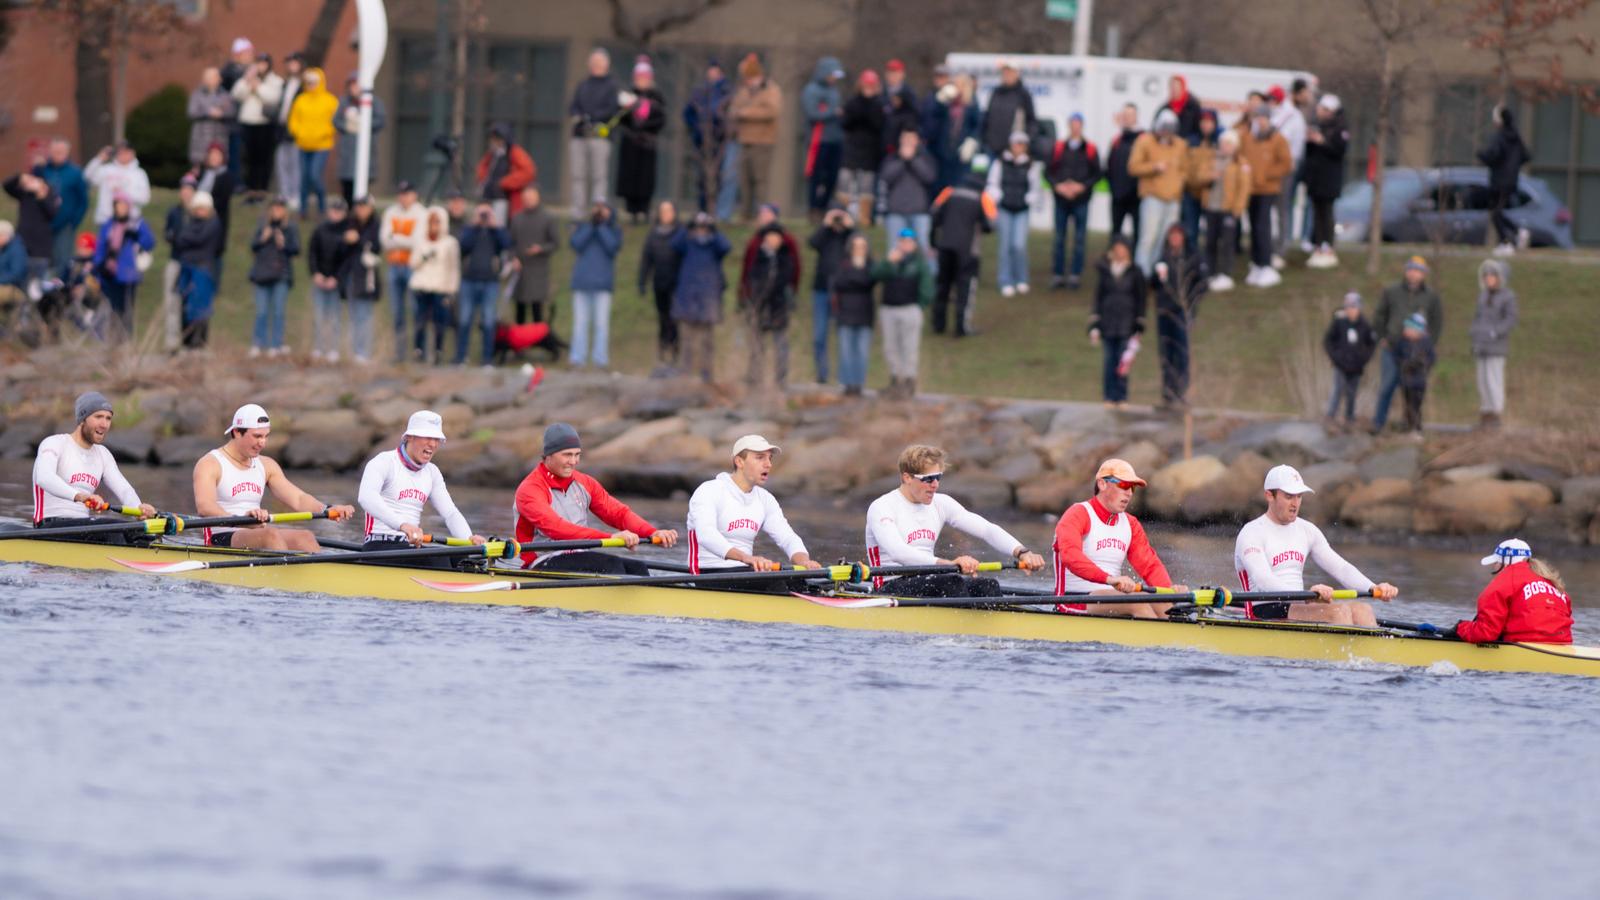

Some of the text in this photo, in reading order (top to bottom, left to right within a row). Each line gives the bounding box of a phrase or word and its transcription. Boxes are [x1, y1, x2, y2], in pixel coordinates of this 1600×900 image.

[71, 472, 98, 488] BOSTON
[232, 482, 262, 497] BOSTON
[398, 489, 428, 503] BOSTON
[727, 519, 759, 532] BOSTON
[907, 529, 936, 544] BOSTON
[1096, 538, 1127, 552] BOSTON
[1272, 550, 1305, 567] BOSTON
